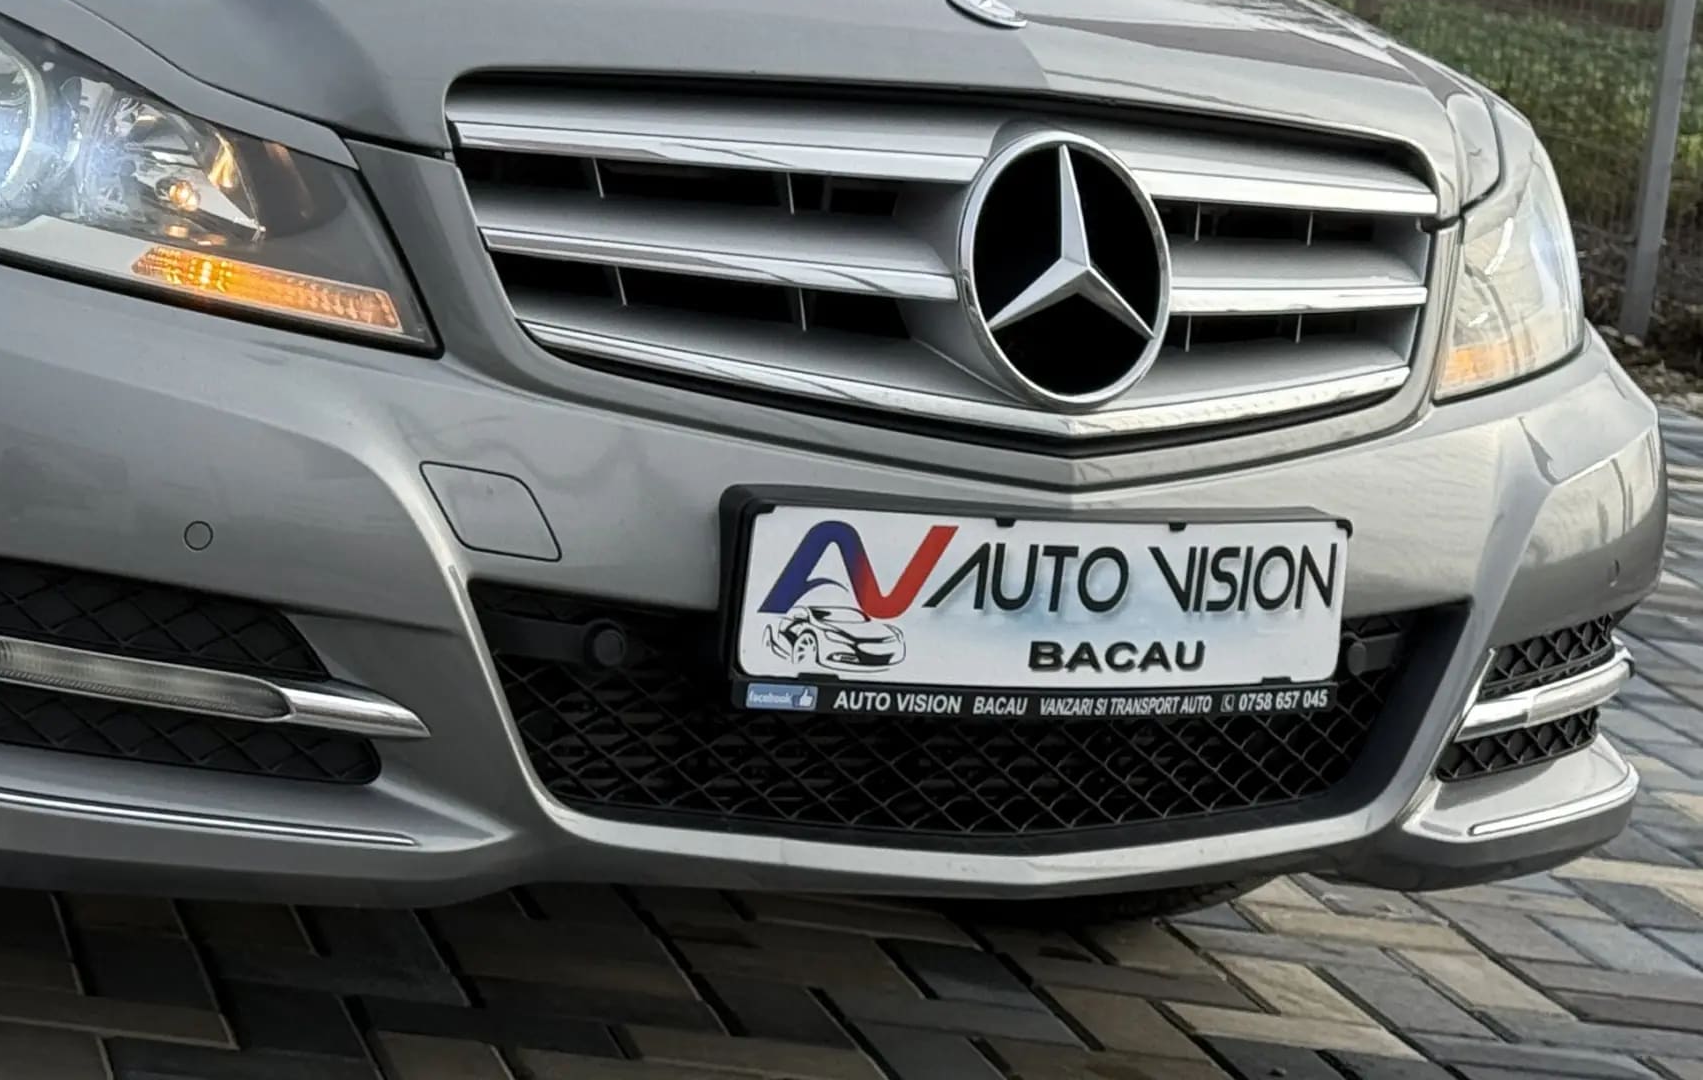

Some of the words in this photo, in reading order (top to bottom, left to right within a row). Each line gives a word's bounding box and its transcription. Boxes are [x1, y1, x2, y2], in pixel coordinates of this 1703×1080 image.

[923, 543, 1129, 613] AUTO
[1149, 541, 1338, 613] VISION
[1028, 640, 1206, 673] BACAU
[834, 691, 891, 711] AUTO
[897, 693, 962, 714] VISION
[973, 696, 1028, 716] BACAU
[1040, 698, 1093, 716] VANZARI
[1110, 696, 1180, 715] TRANSPORT
[1180, 695, 1212, 714] AUTO
[1239, 692, 1272, 712] 0758
[1276, 691, 1300, 710] 657
[1303, 689, 1329, 708] 045
